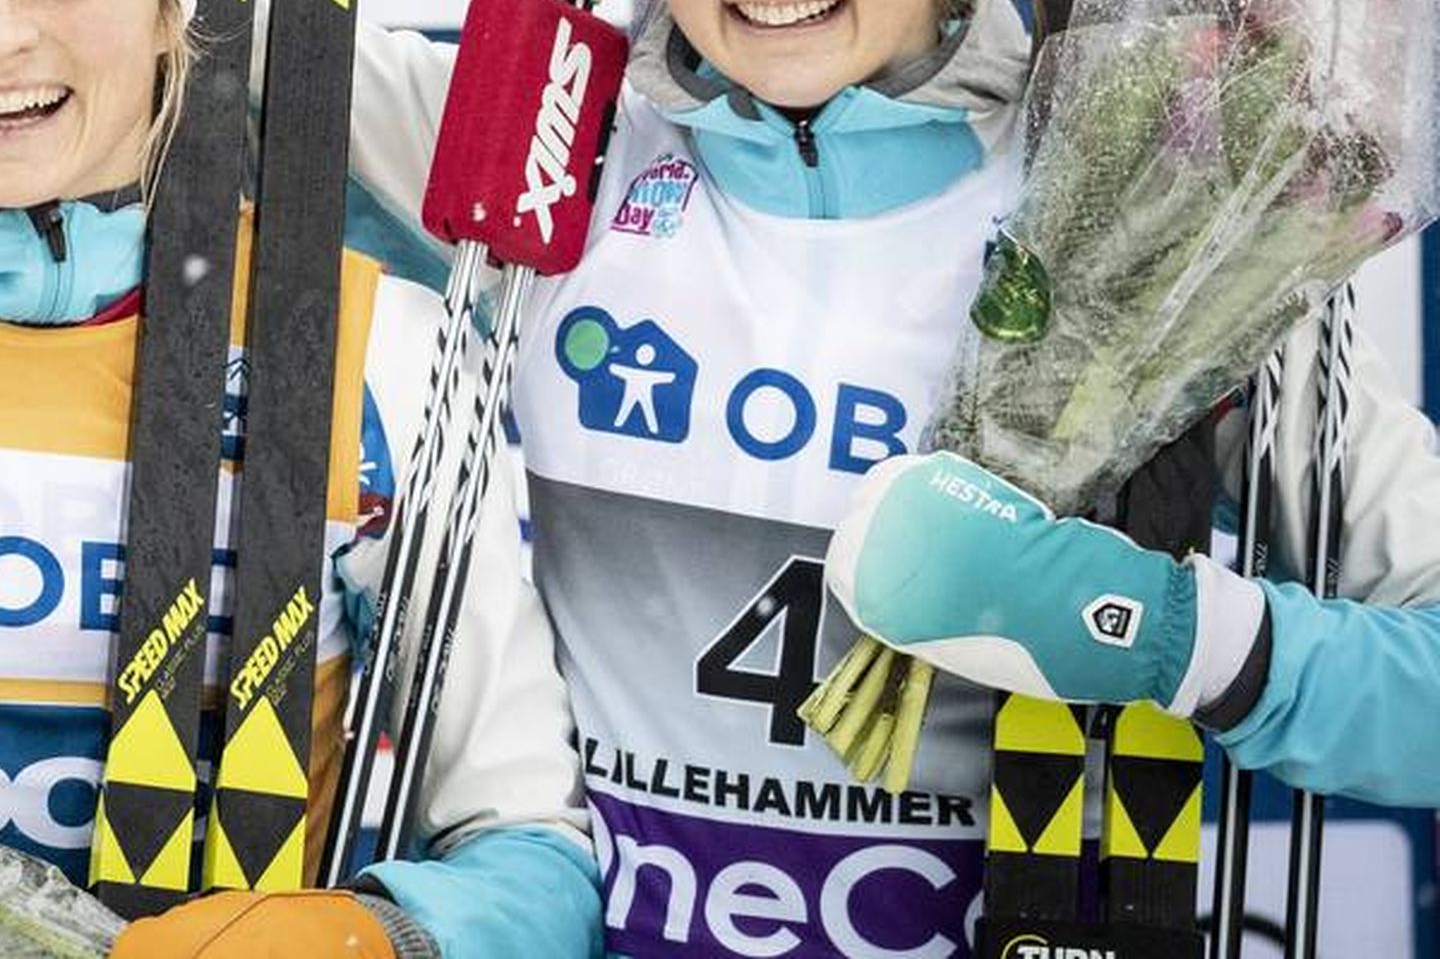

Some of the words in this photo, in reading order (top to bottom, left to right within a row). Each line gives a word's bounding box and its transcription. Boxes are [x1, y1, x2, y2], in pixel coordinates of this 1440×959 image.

[929, 470, 1017, 522] HESTRA
[693, 555, 827, 747] 4
[584, 738, 976, 827] LILLEHAMMER
[588, 796, 984, 959] neC
